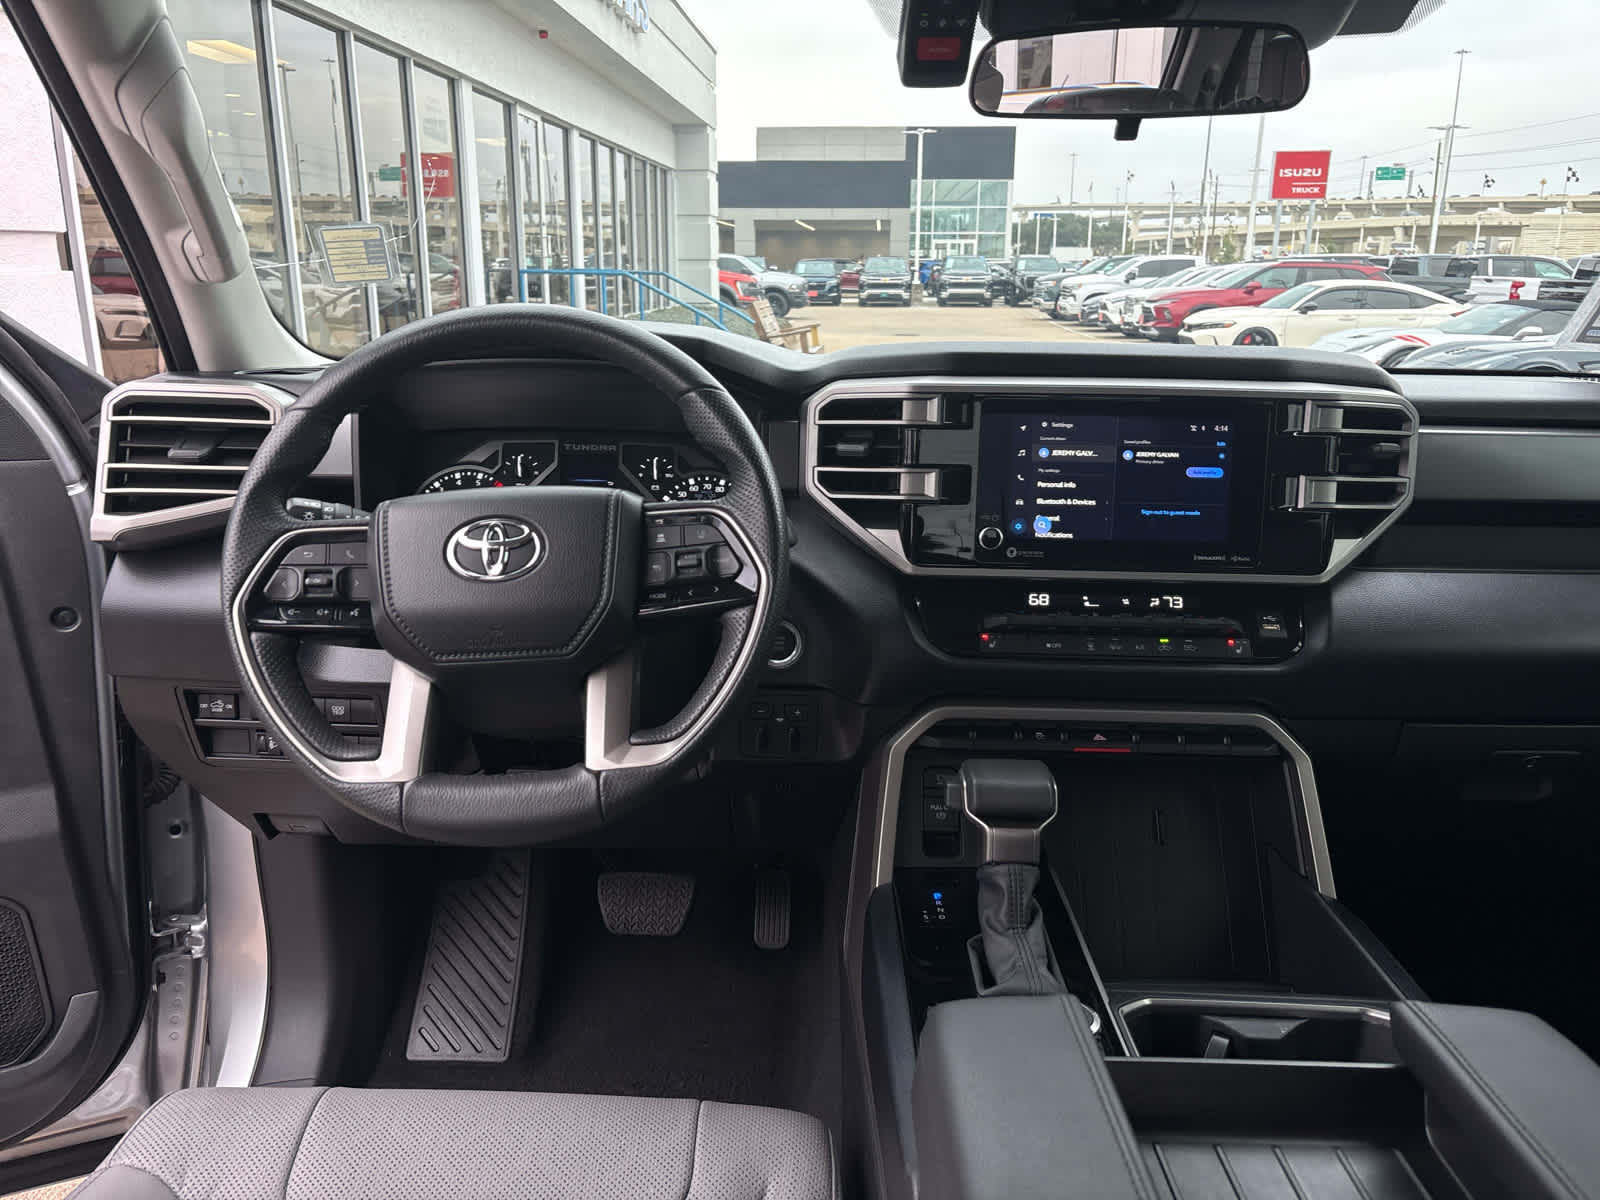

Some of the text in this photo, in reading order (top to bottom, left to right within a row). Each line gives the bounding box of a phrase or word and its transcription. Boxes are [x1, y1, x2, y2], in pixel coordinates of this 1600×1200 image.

[1279, 168, 1322, 177] ISUZU
[1028, 593, 1050, 606] 68
[1163, 596, 1184, 608] 73
